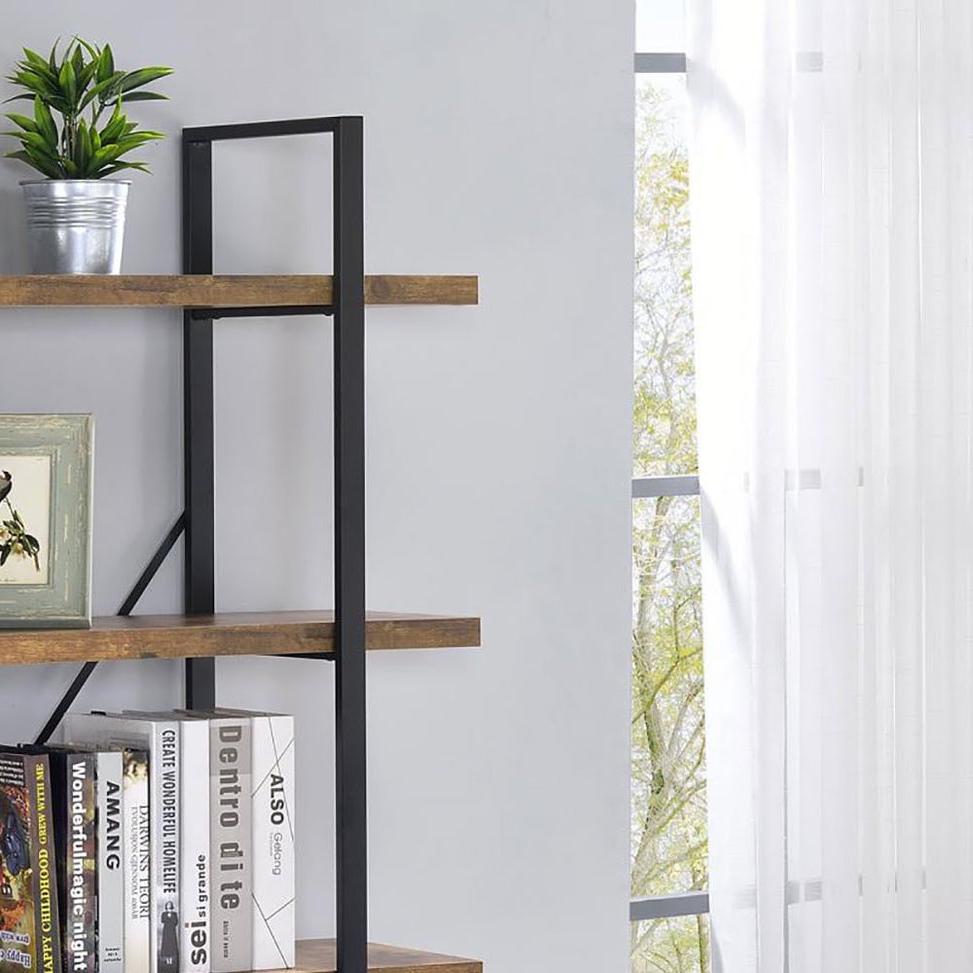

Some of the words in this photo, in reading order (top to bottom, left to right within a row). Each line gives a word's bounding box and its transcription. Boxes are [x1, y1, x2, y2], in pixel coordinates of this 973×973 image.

[35, 763, 44, 779] ME
[162, 730, 176, 767] CREATE
[36, 780, 46, 813] WITH
[218, 725, 242, 828] Dentro
[162, 770, 176, 840] WONDERFUL
[270, 774, 284, 825] ALSO
[37, 813, 47, 845] GREW
[105, 781, 120, 870] AMANG
[139, 805, 149, 872] DARWINS
[163, 841, 176, 893] HOMELIFE
[196, 854, 208, 902] grande
[220, 842, 243, 871] di
[39, 848, 52, 933] CHILDHOOD
[139, 876, 149, 919] TEORI
[196, 903, 206, 917] si
[220, 880, 243, 910] te
[6, 949, 31, 967] Happy
[72, 921, 88, 971] night
[185, 920, 207, 965] sei
